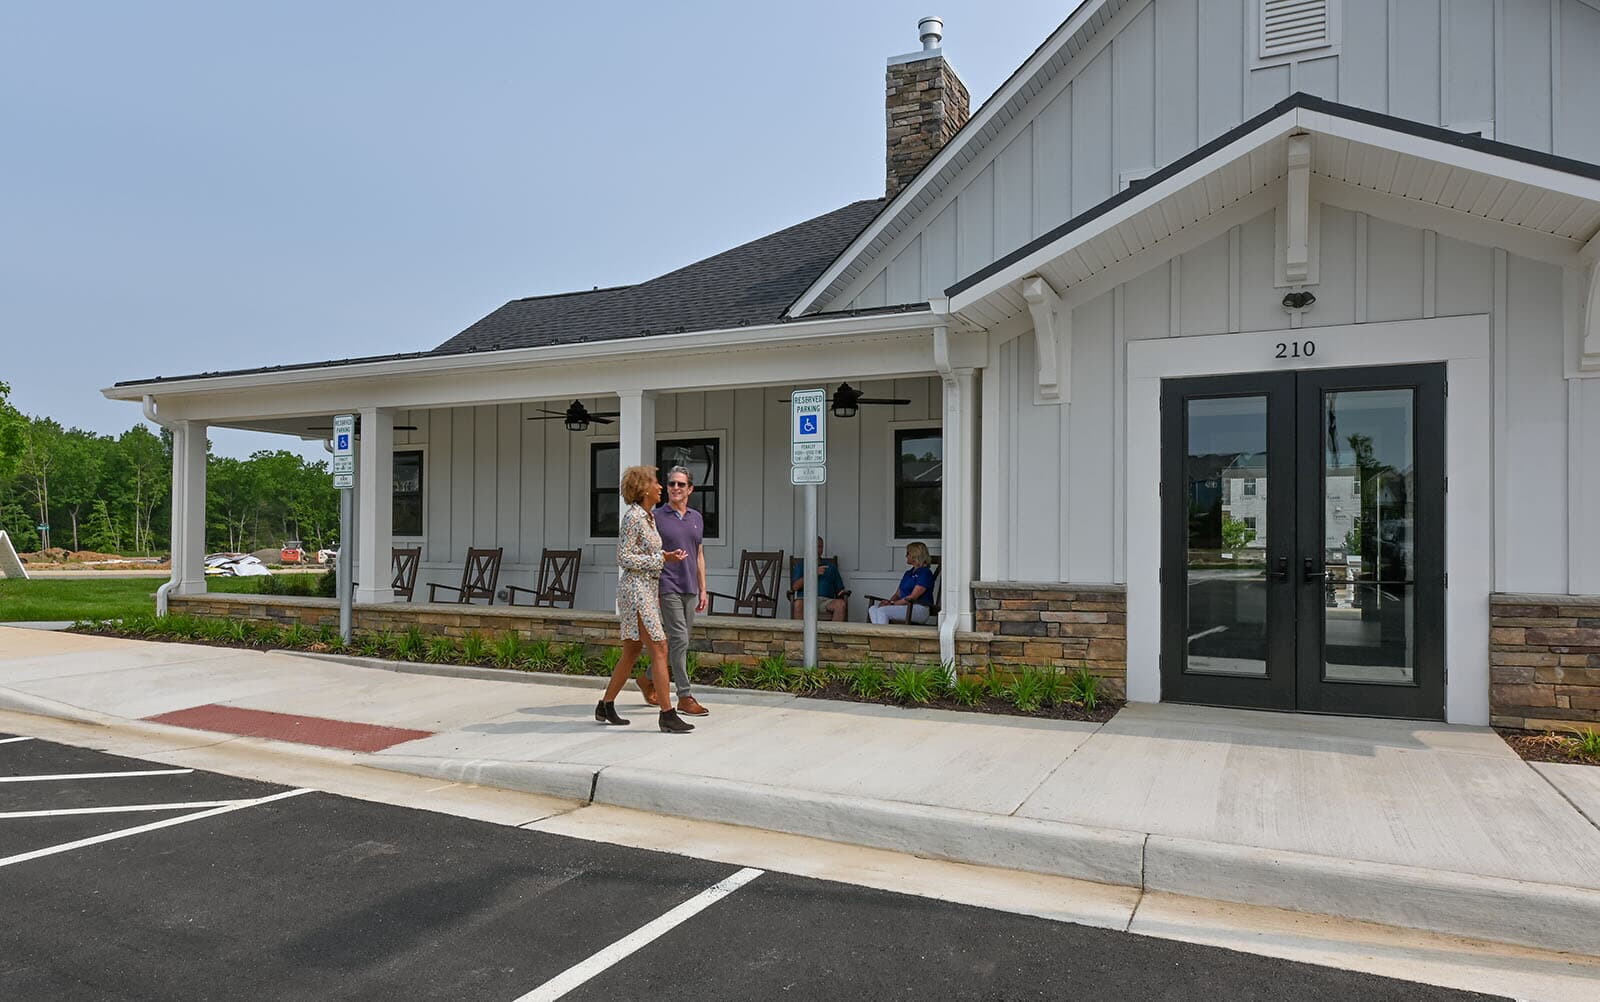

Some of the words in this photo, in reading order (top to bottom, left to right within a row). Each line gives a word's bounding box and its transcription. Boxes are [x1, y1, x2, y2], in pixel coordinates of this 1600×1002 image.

[1275, 341, 1315, 359] 210
[795, 396, 822, 405] RESERVED
[797, 405, 820, 414] PARKING
